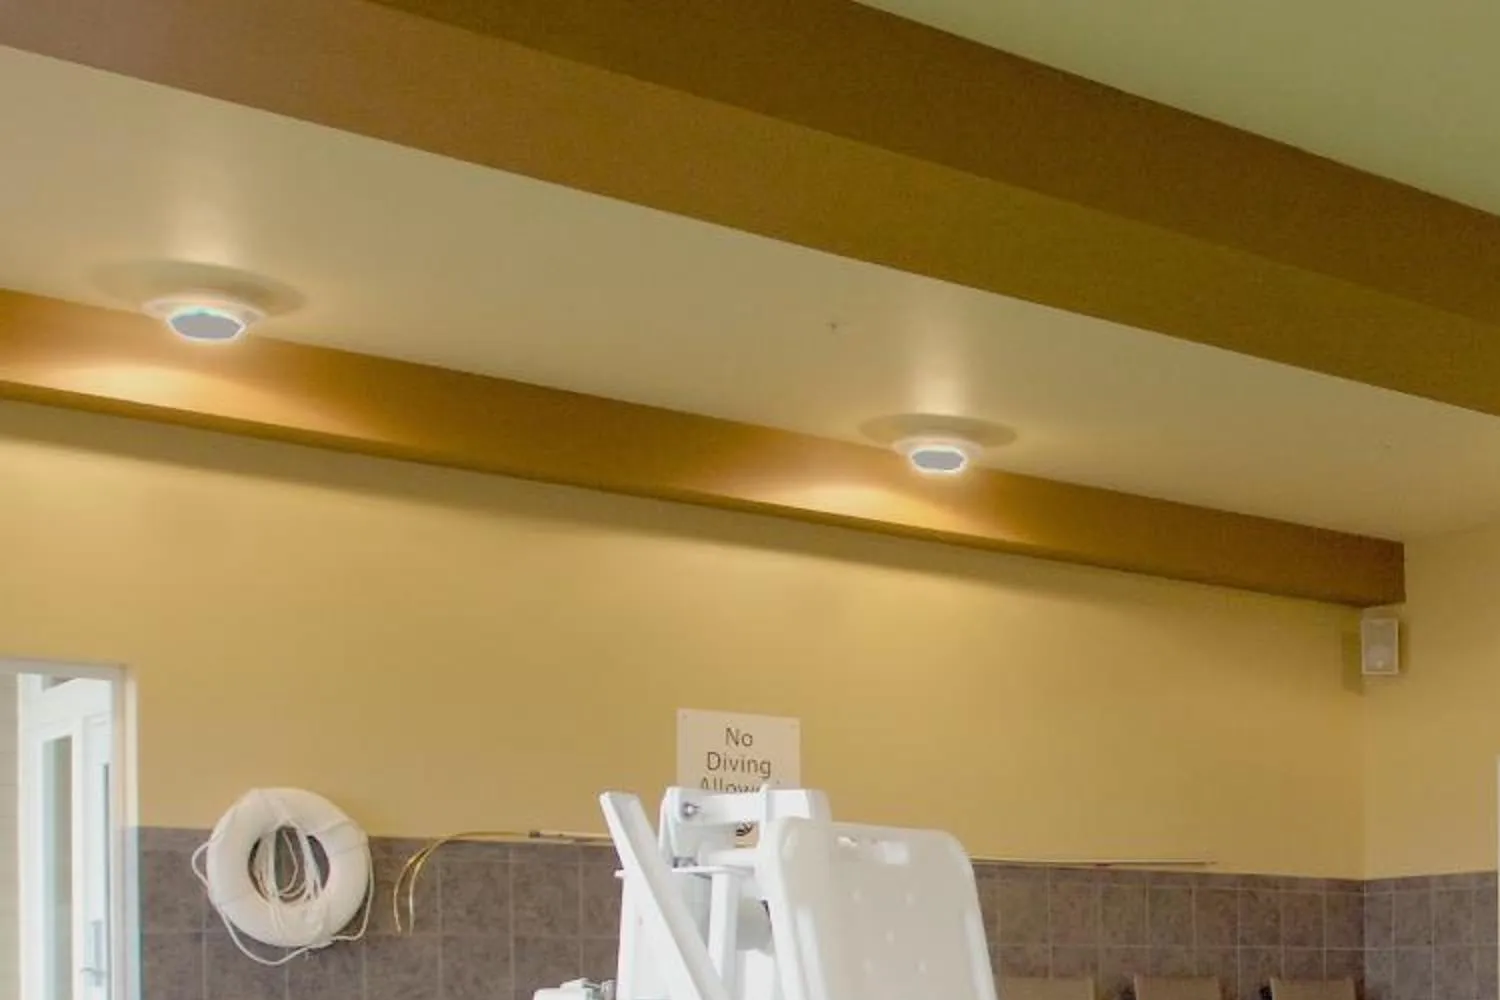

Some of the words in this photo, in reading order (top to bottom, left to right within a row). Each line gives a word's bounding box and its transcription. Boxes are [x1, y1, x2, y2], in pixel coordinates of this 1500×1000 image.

[725, 727, 753, 747] No
[706, 751, 771, 779] Diving
[701, 775, 779, 793] Allow
